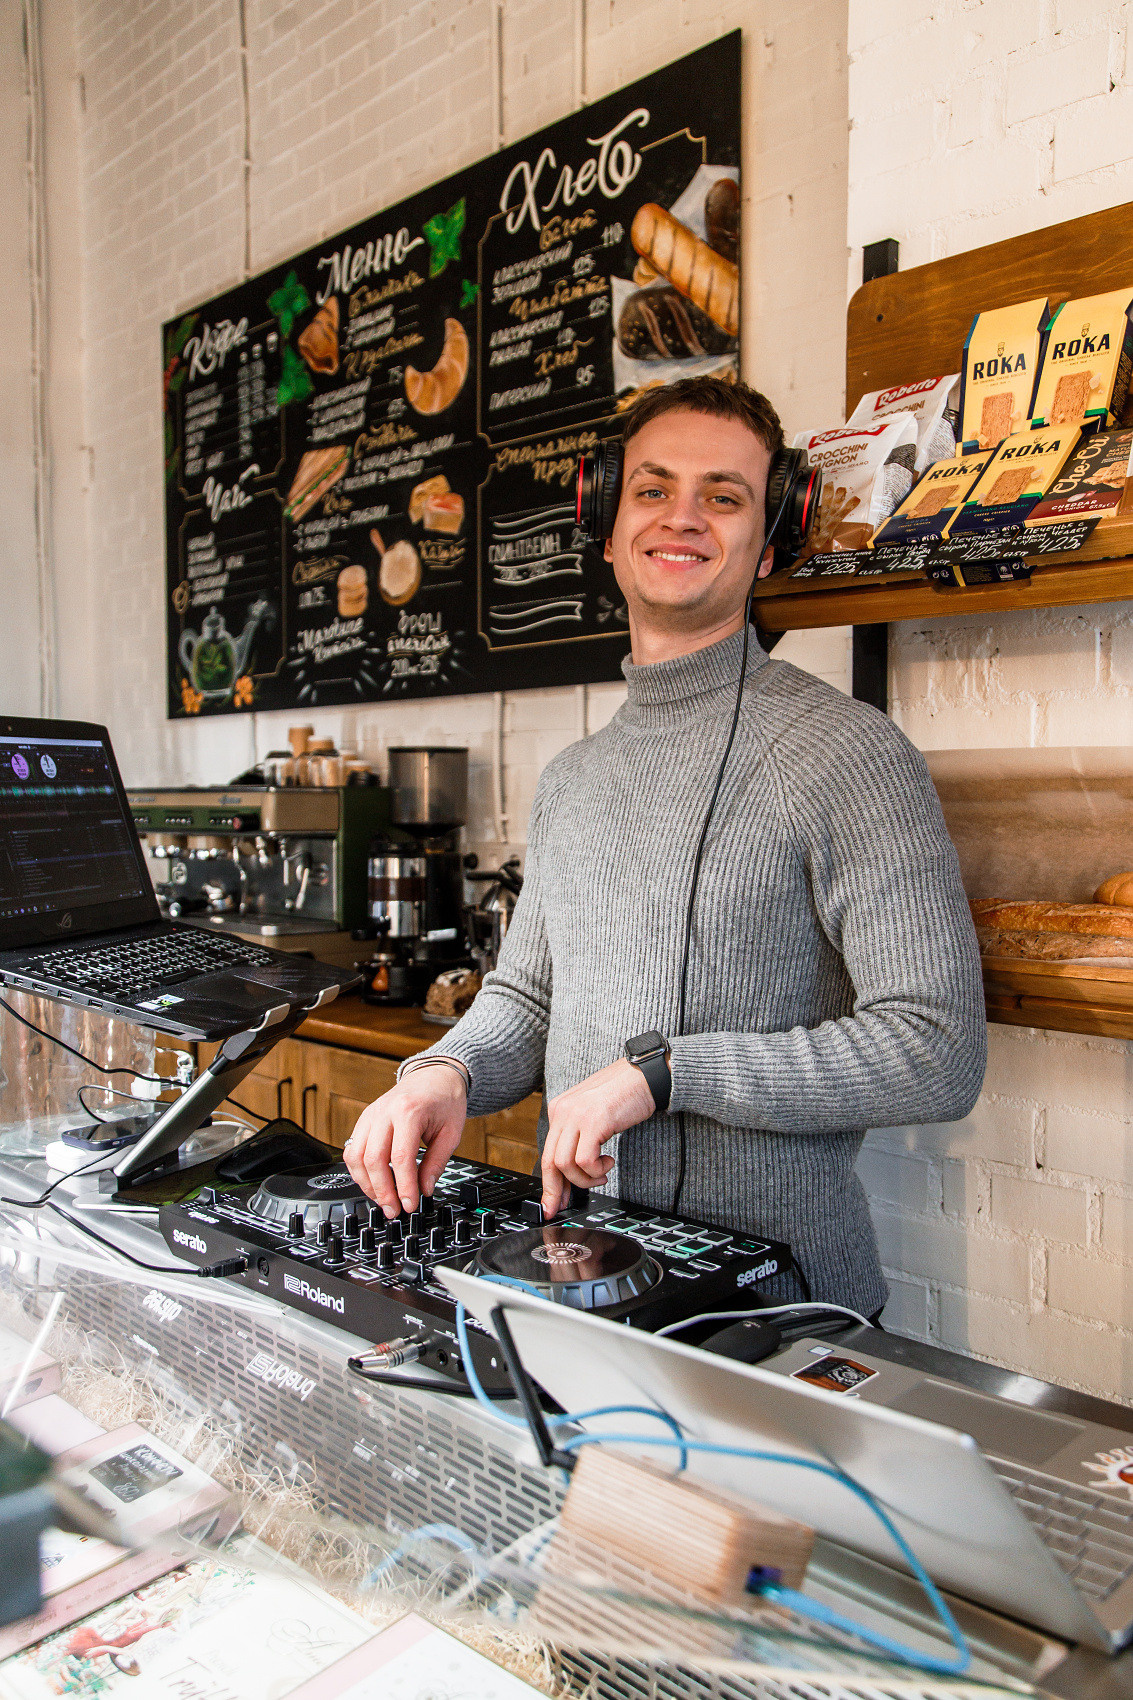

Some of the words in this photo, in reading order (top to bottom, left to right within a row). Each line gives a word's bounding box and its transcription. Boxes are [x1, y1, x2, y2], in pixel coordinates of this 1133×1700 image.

[499, 107, 650, 234] Хлеб
[316, 227, 425, 306] Меню
[183, 316, 249, 383] Кофе
[1051, 333, 1111, 361] ROKA
[972, 353, 1027, 381] ROKA
[877, 378, 937, 408] Roberto
[809, 443, 869, 463] CROCCHINI
[1000, 440, 1061, 461] ROKA
[927, 462, 985, 481] ROKA
[202, 463, 260, 524] Чай
[1051, 500, 1098, 511] CHEDDAR
[488, 532, 561, 564] ГЛИНТВЕЙН
[173, 1229, 208, 1254] serato
[737, 1259, 778, 1288] serato
[300, 1282, 345, 1315] Roland
